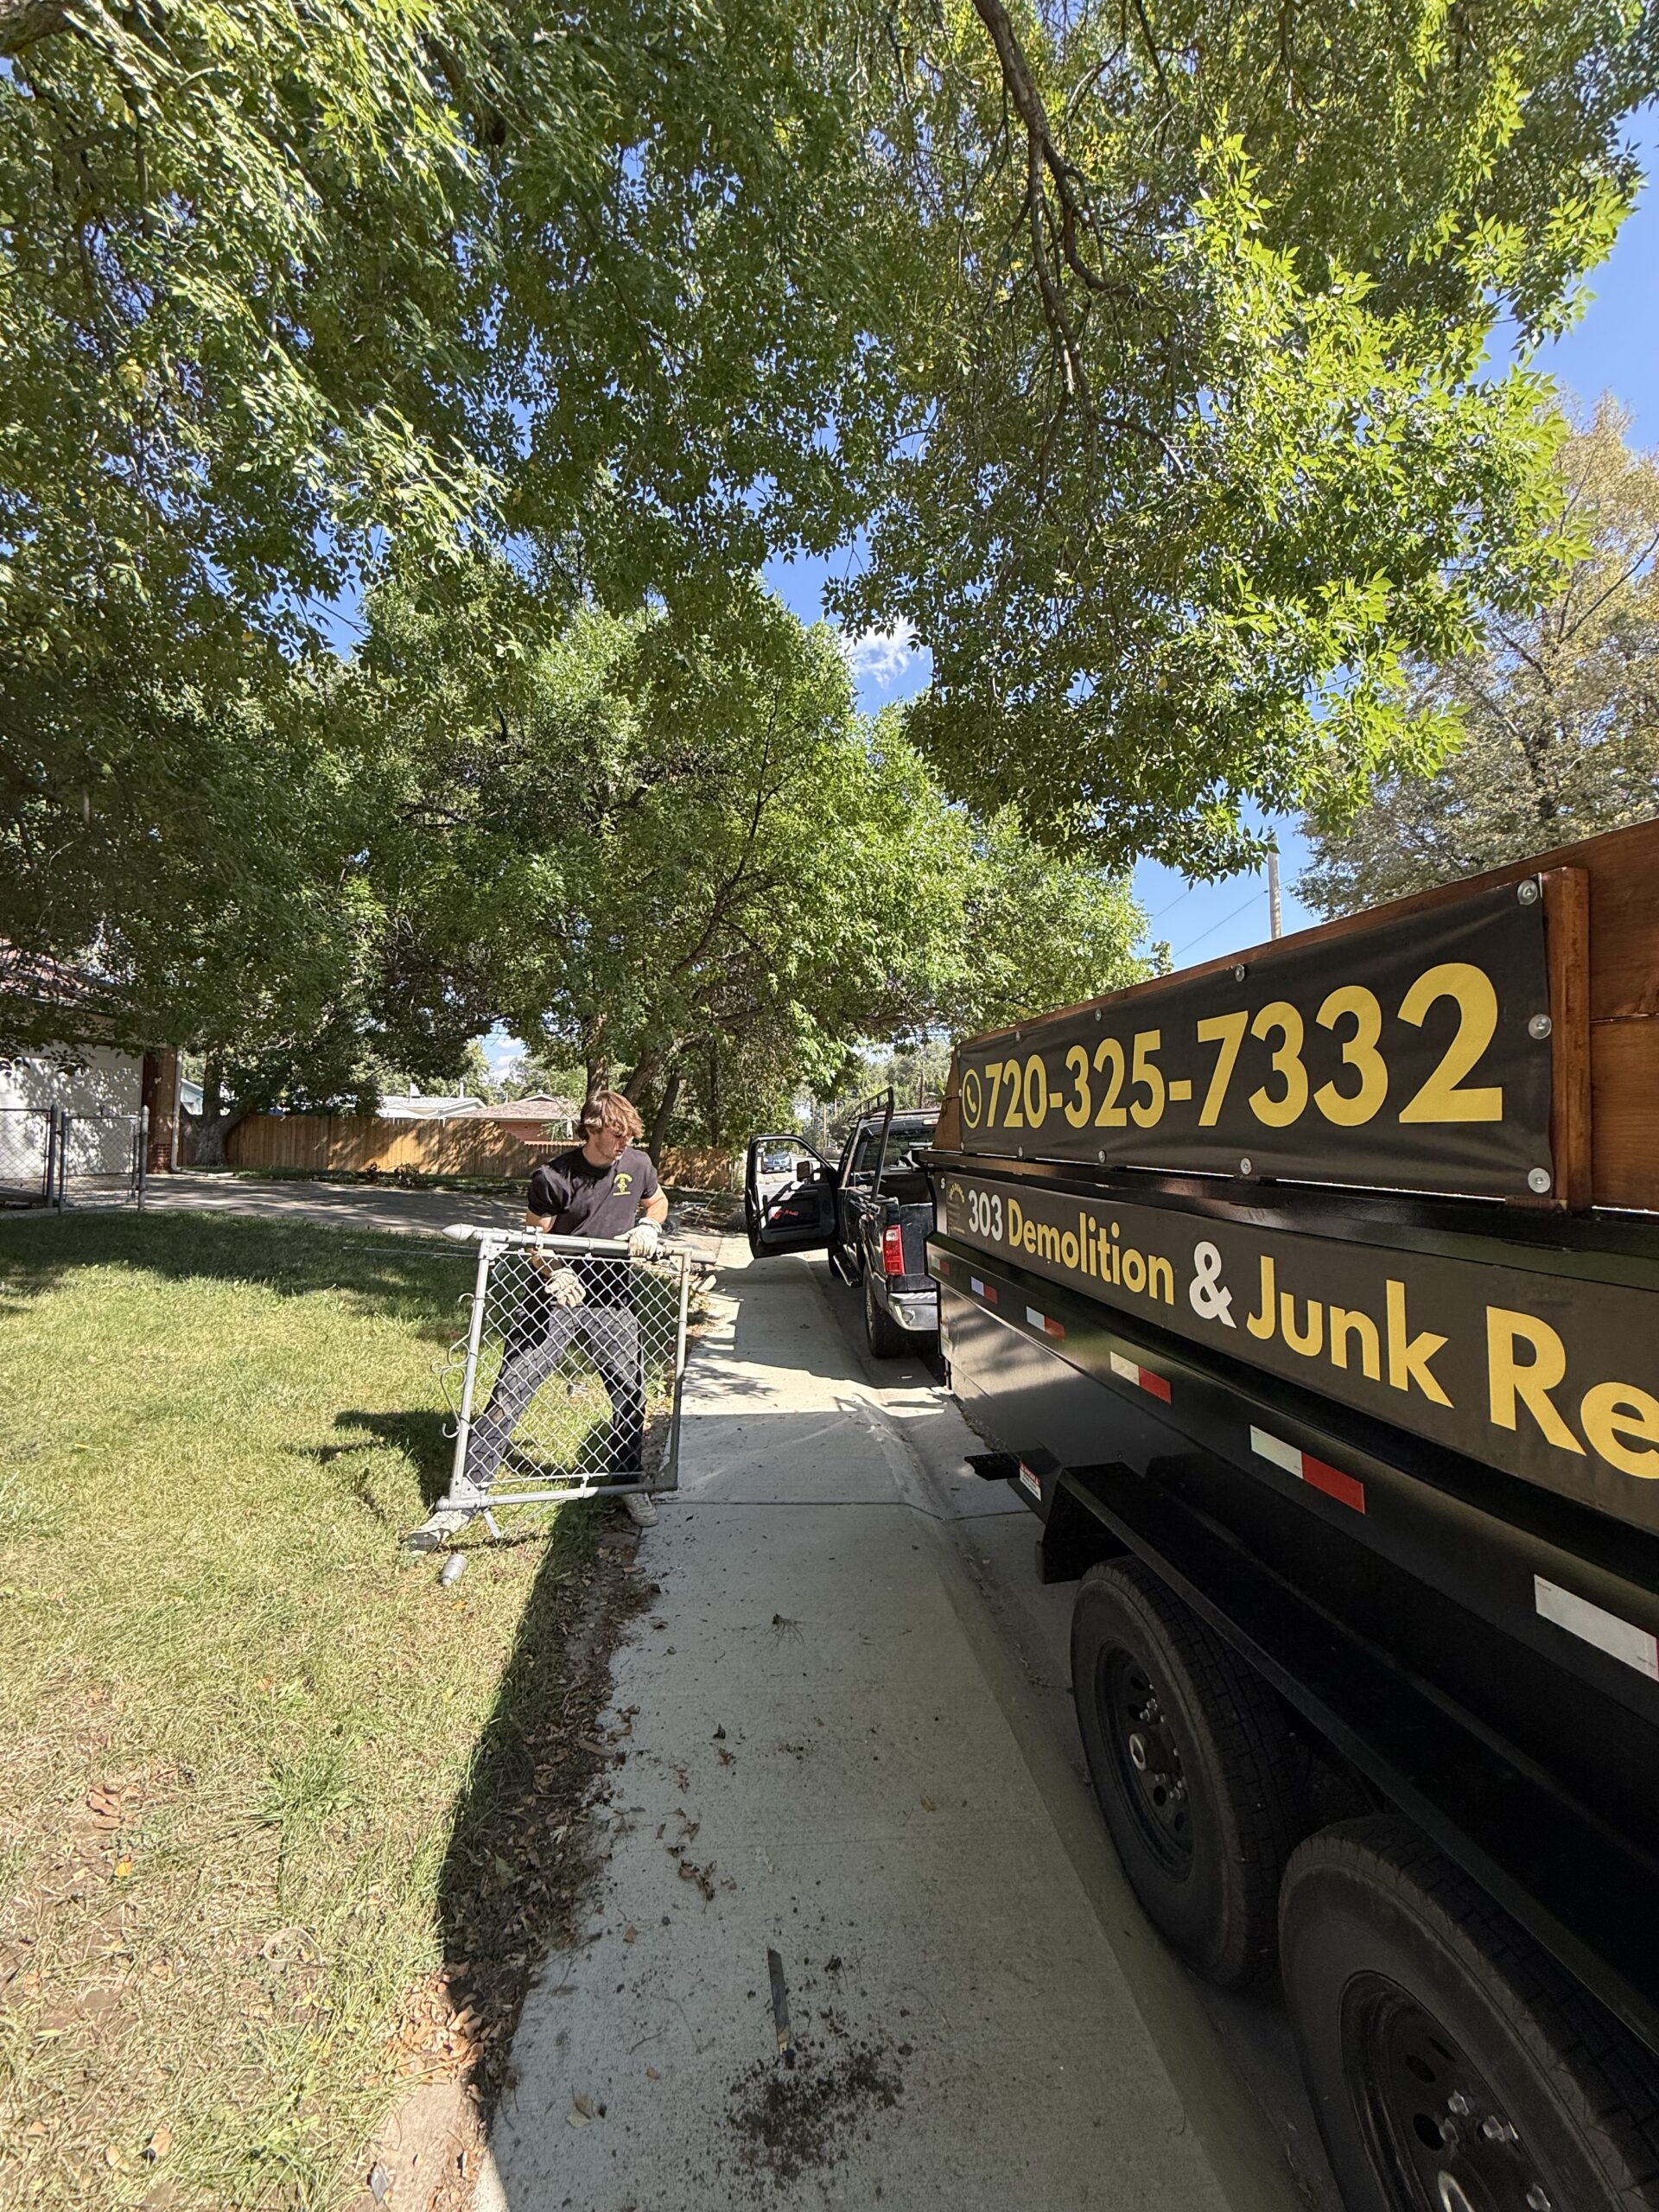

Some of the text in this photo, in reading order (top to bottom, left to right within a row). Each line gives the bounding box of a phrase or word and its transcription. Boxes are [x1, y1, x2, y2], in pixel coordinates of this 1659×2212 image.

[985, 963, 1503, 1128] 720-325-7332
[968, 1189, 1659, 1479] 303 Demolition & Junk Re
